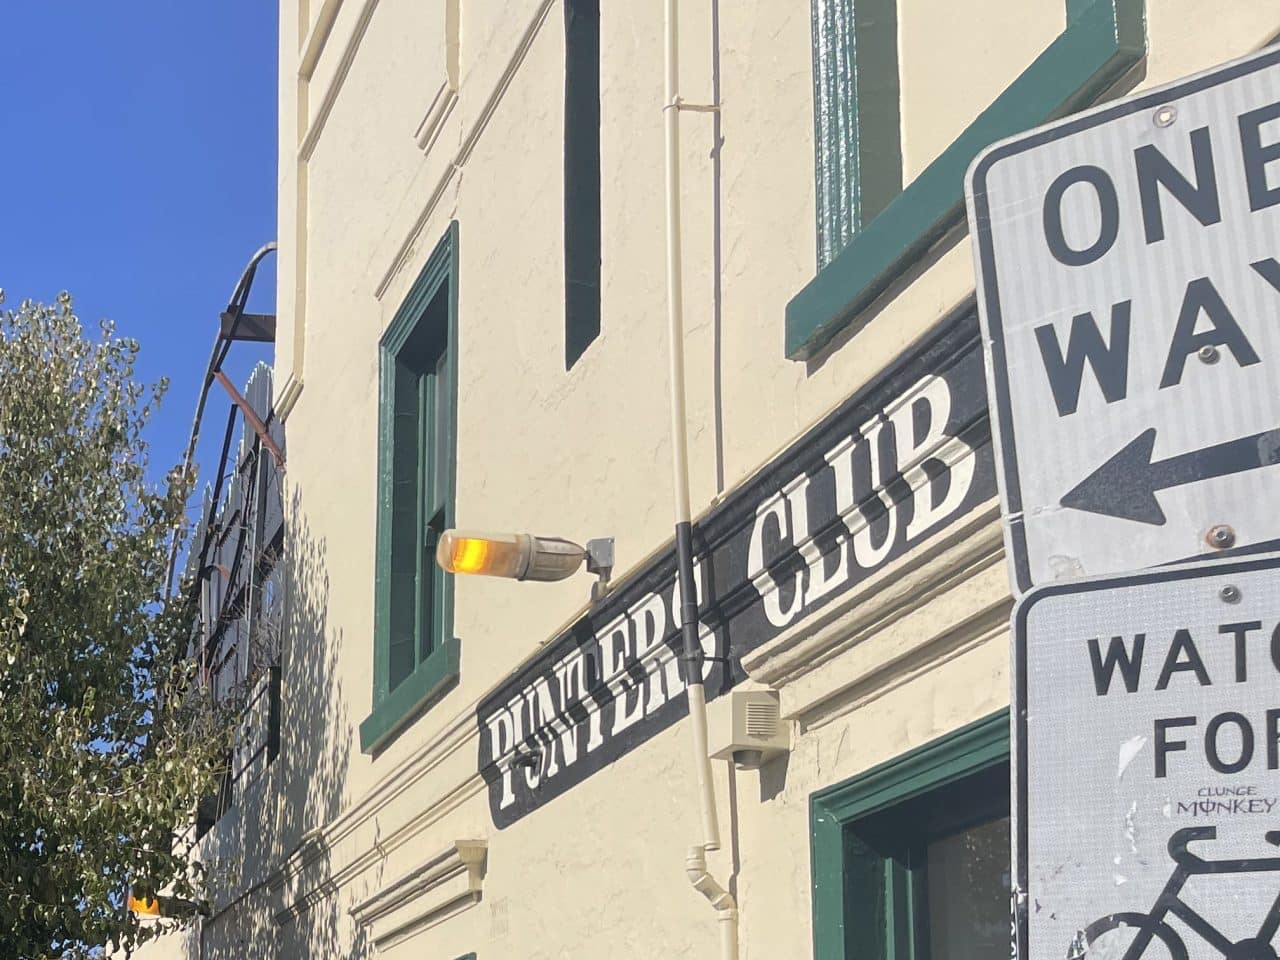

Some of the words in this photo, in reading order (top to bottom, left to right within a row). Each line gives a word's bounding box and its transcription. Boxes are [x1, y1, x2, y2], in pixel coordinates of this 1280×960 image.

[1042, 102, 1280, 267] ONE
[747, 375, 976, 628] CLUB
[1087, 620, 1280, 697] WAT
[1153, 708, 1280, 778] FO
[1197, 786, 1258, 797] CLUNGE
